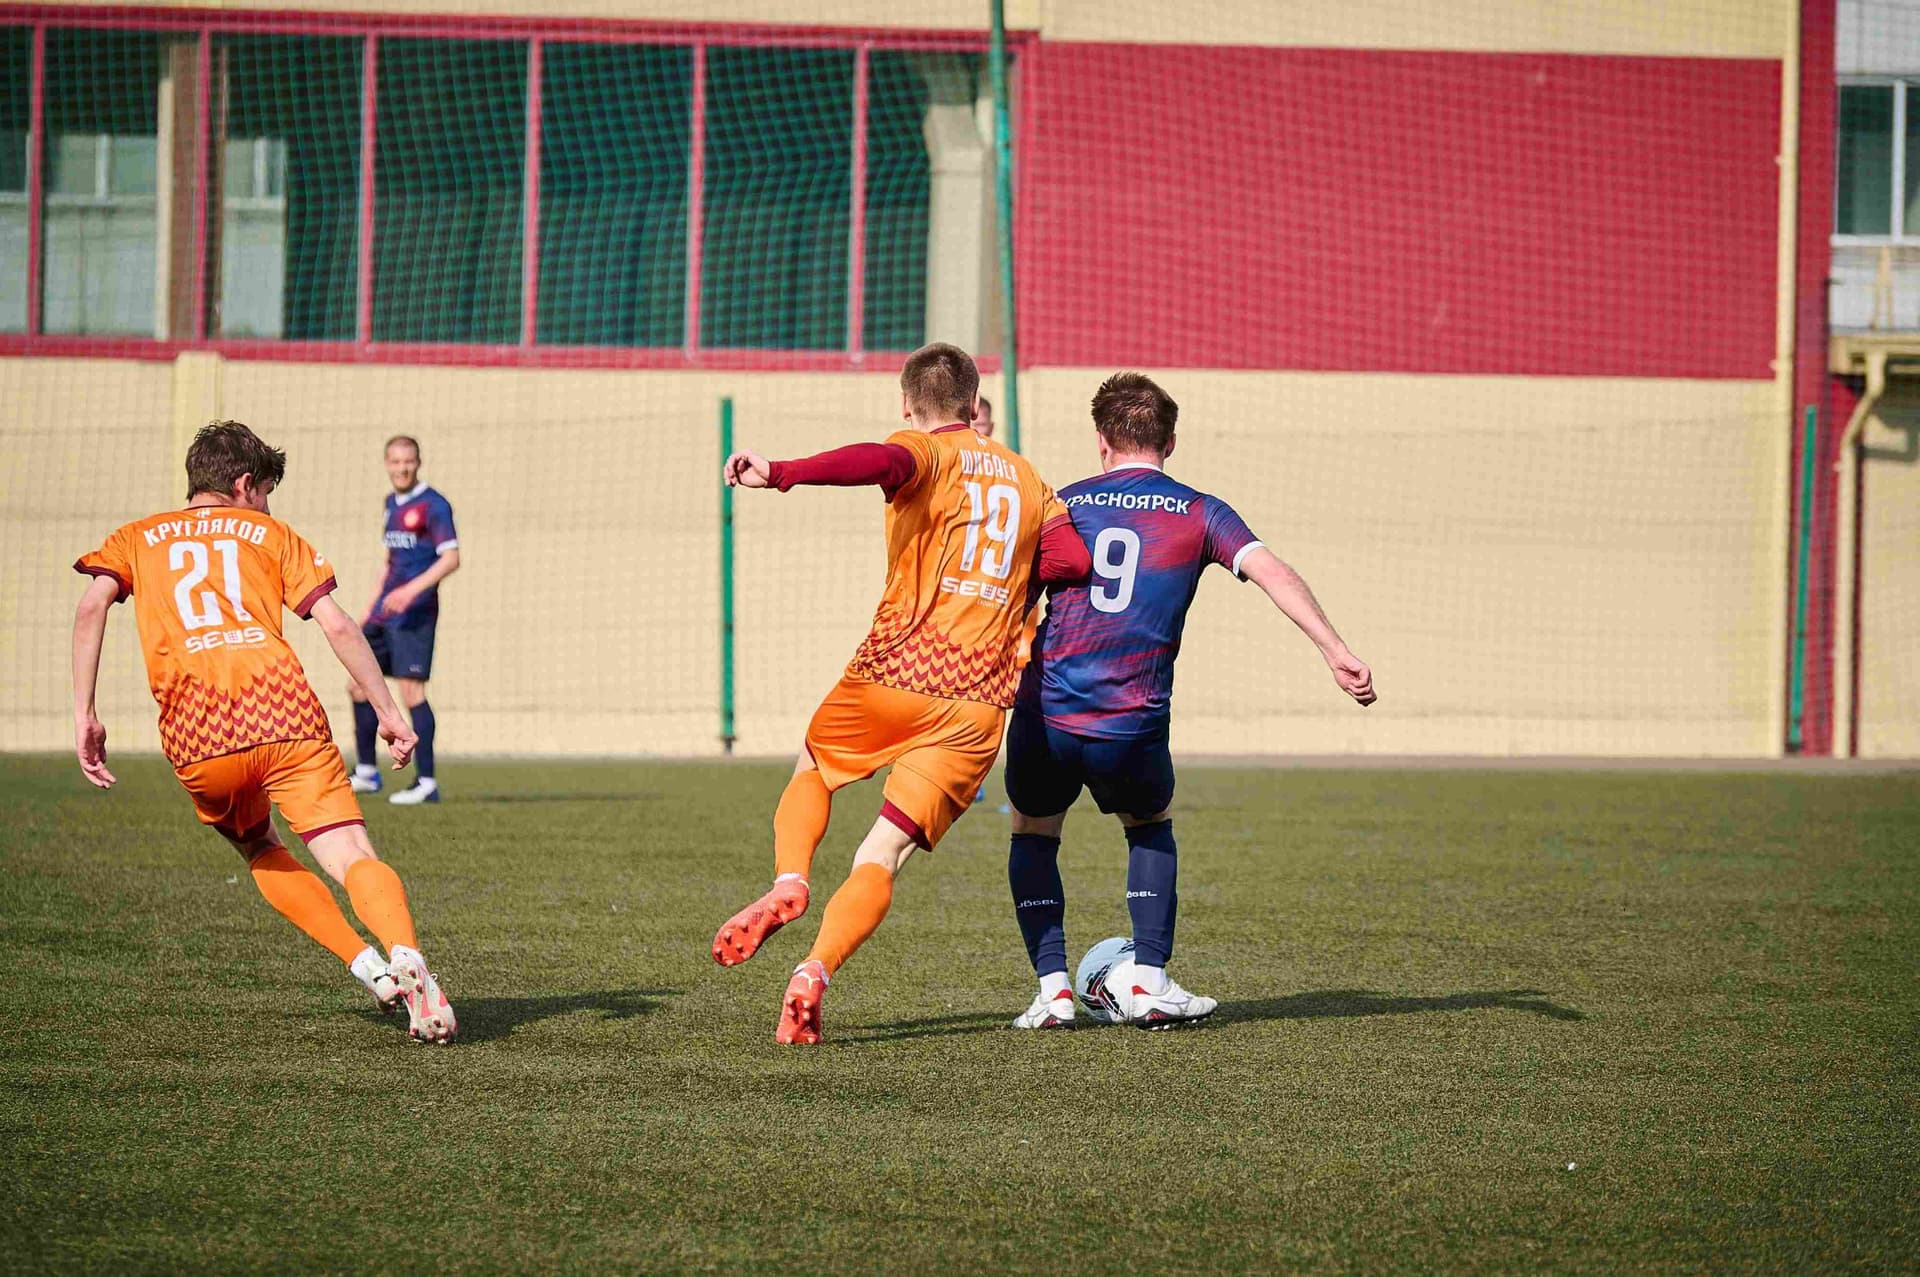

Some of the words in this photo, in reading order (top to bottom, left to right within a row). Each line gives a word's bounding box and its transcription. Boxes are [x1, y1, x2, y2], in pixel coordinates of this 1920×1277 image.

[143, 518, 267, 547] КРУГЛЯКОВ
[960, 481, 1021, 579] 19
[1090, 527, 1140, 613] 9
[169, 539, 252, 630] 21
